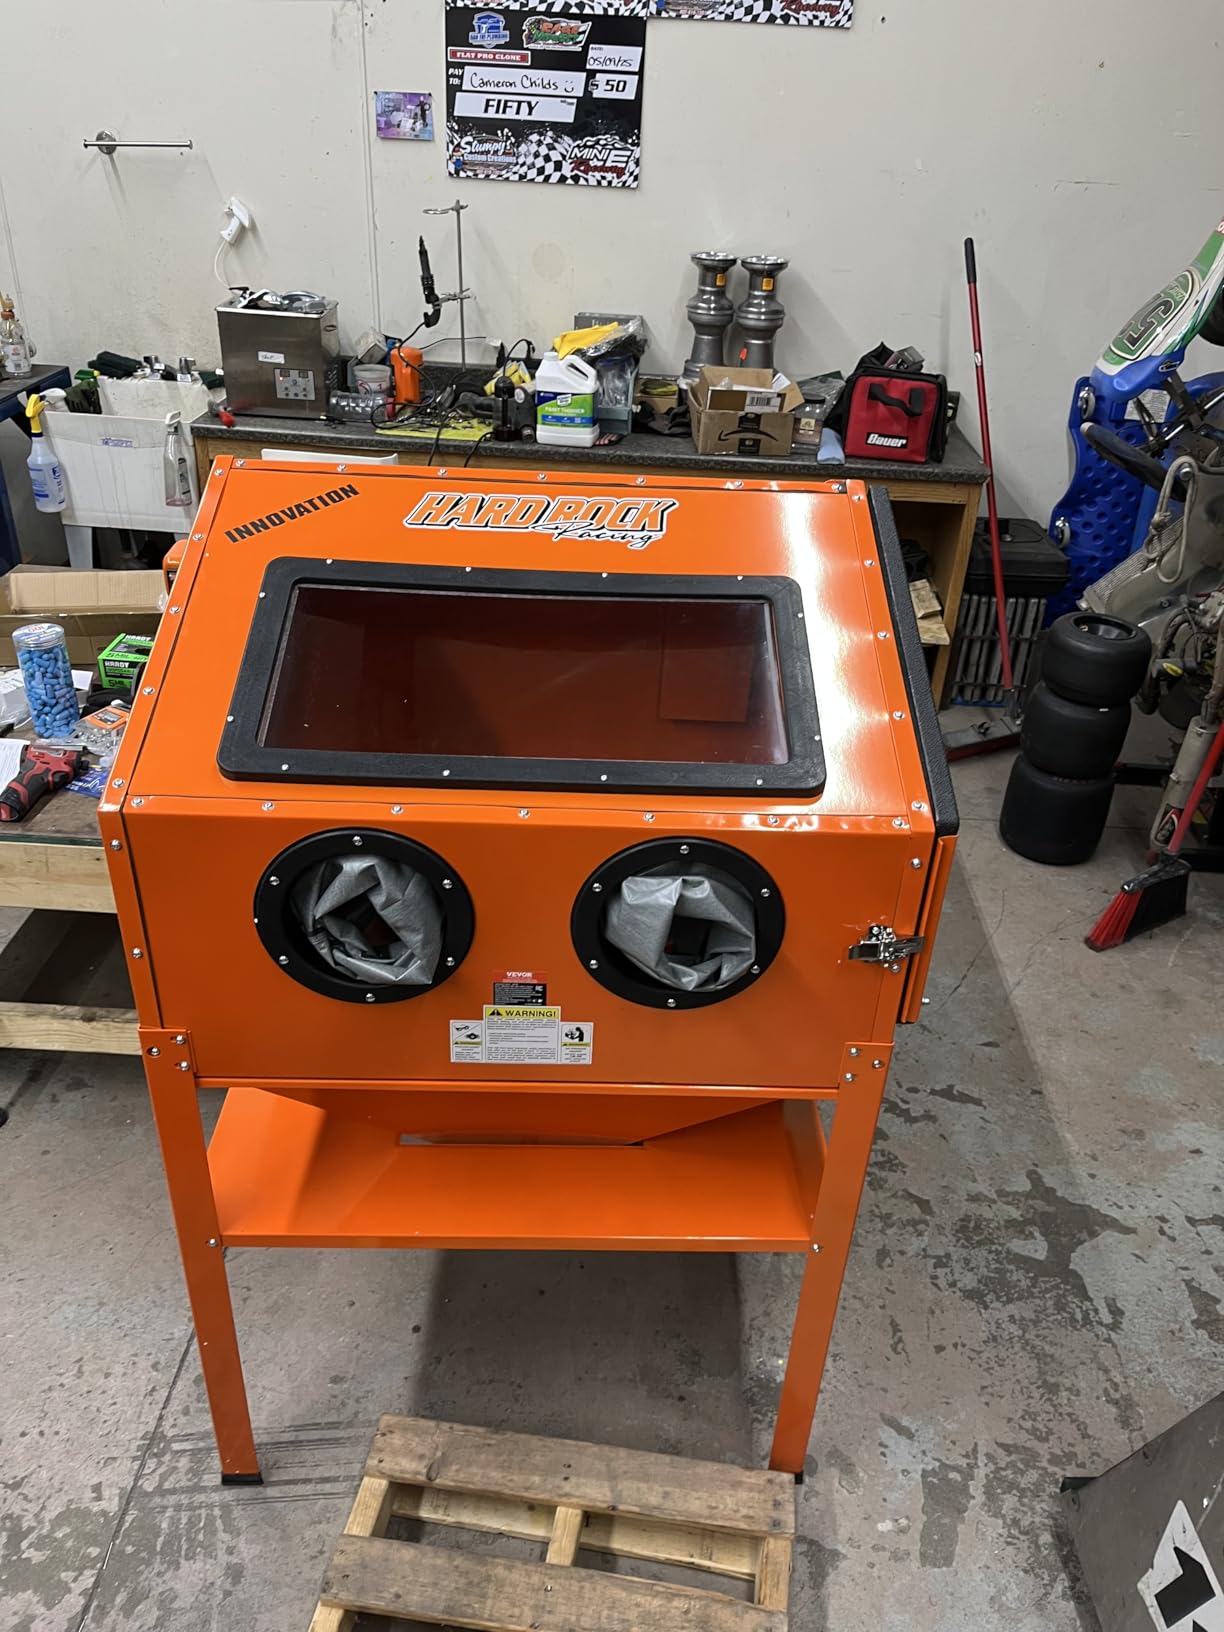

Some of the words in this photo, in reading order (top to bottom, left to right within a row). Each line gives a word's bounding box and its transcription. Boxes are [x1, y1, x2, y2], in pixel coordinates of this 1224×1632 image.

[448, 68, 464, 76] PAY
[449, 77, 461, 85] TO:
[470, 72, 517, 89] Cameron
[520, 74, 559, 90] Childs
[604, 79, 627, 93] 50
[483, 98, 540, 116] FIFTY
[867, 433, 907, 448] Bauer
[224, 483, 360, 543] INNOVATION
[405, 493, 551, 530] HARD
[543, 497, 677, 532] ROCK
[531, 520, 660, 548] Racing
[505, 1009, 556, 1018] WARNING!
